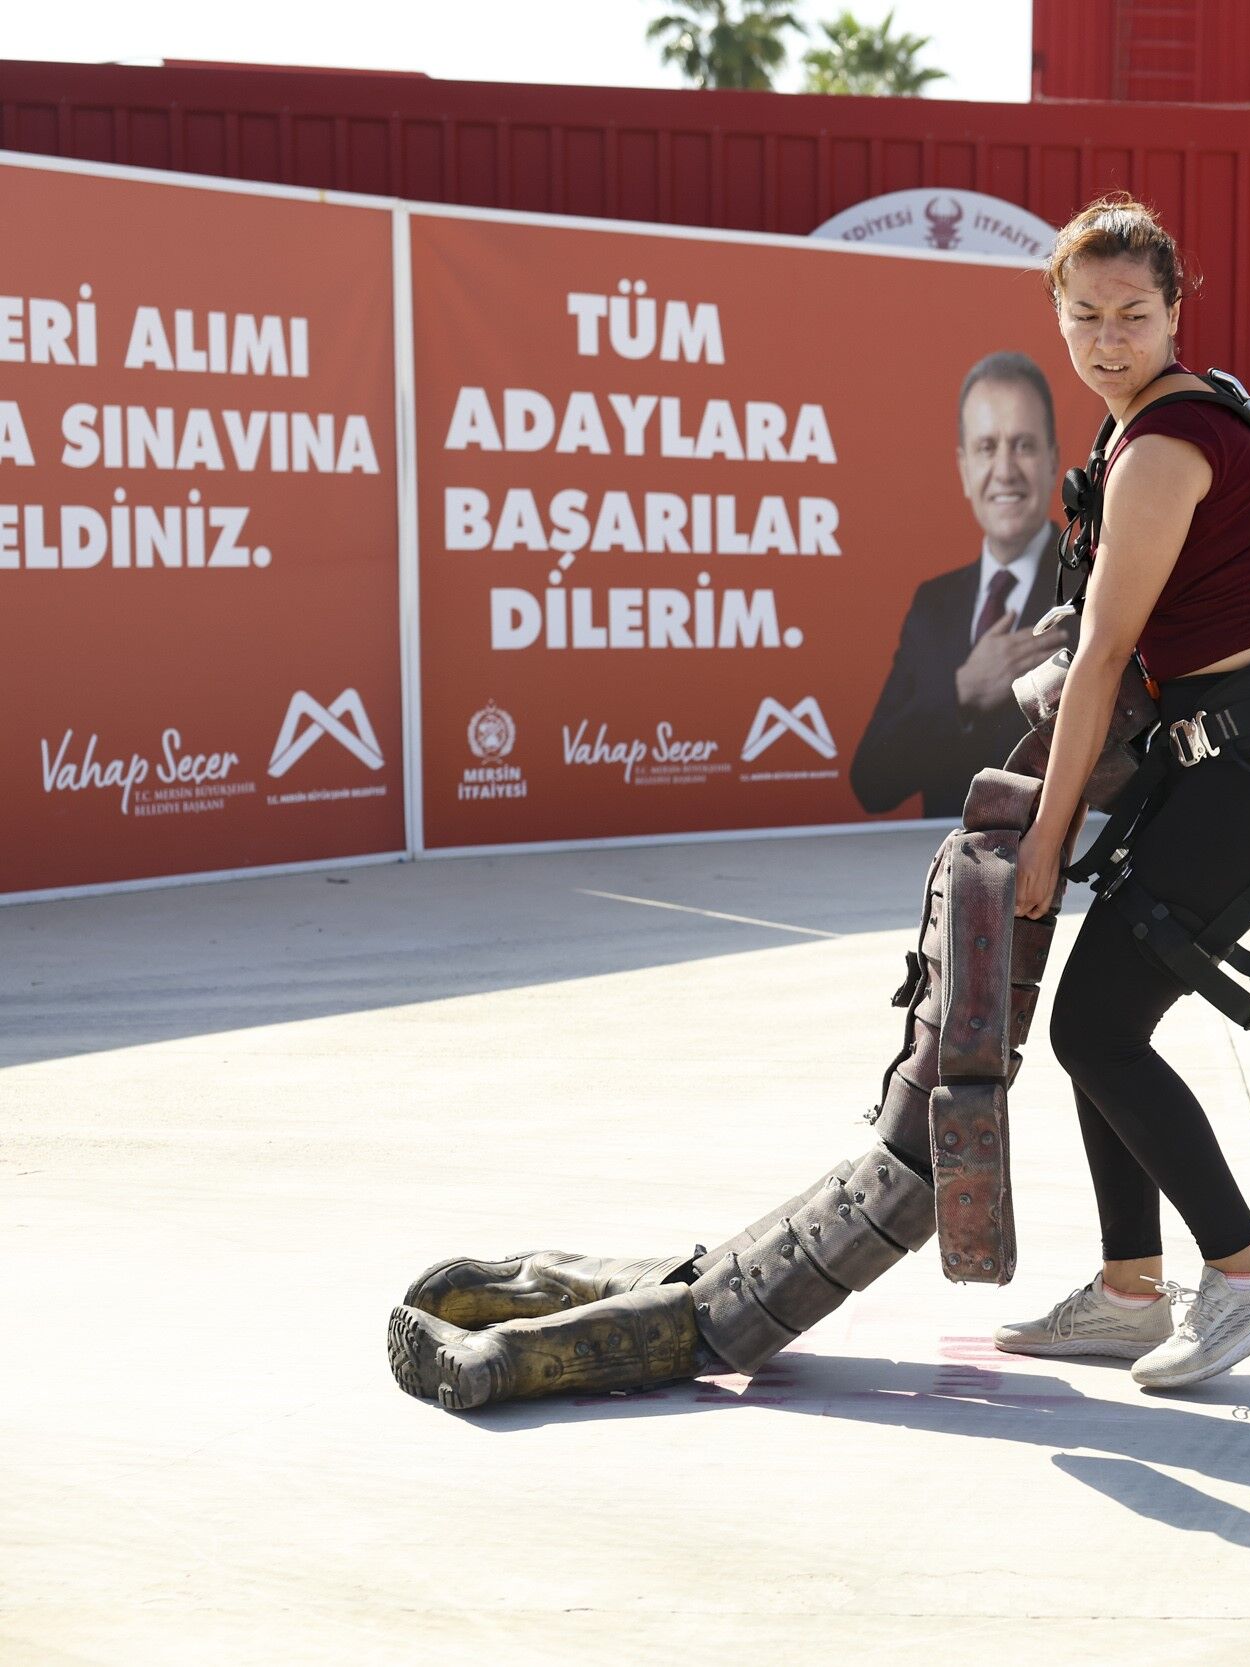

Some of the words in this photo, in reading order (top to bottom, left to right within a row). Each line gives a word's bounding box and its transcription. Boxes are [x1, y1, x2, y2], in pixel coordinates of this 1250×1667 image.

[973, 209, 1042, 257] İTFAİYE
[0, 283, 98, 366] ERİ
[124, 306, 309, 378] ALIMI
[567, 279, 725, 365] TÜM
[0, 401, 36, 466] A
[61, 403, 380, 474] SINAVINA
[444, 387, 837, 464] ADAYLARA
[0, 486, 272, 569] ELDİNİZ.
[444, 487, 841, 570] BAŞARILAR
[490, 570, 804, 651] DİLERİM.
[41, 728, 148, 815] Vahap
[156, 727, 239, 786] Seçer
[458, 779, 528, 800] İTFAİYESİ
[463, 763, 521, 783] MERSİN
[562, 719, 647, 784] Vahap
[652, 721, 718, 765] Seçer
